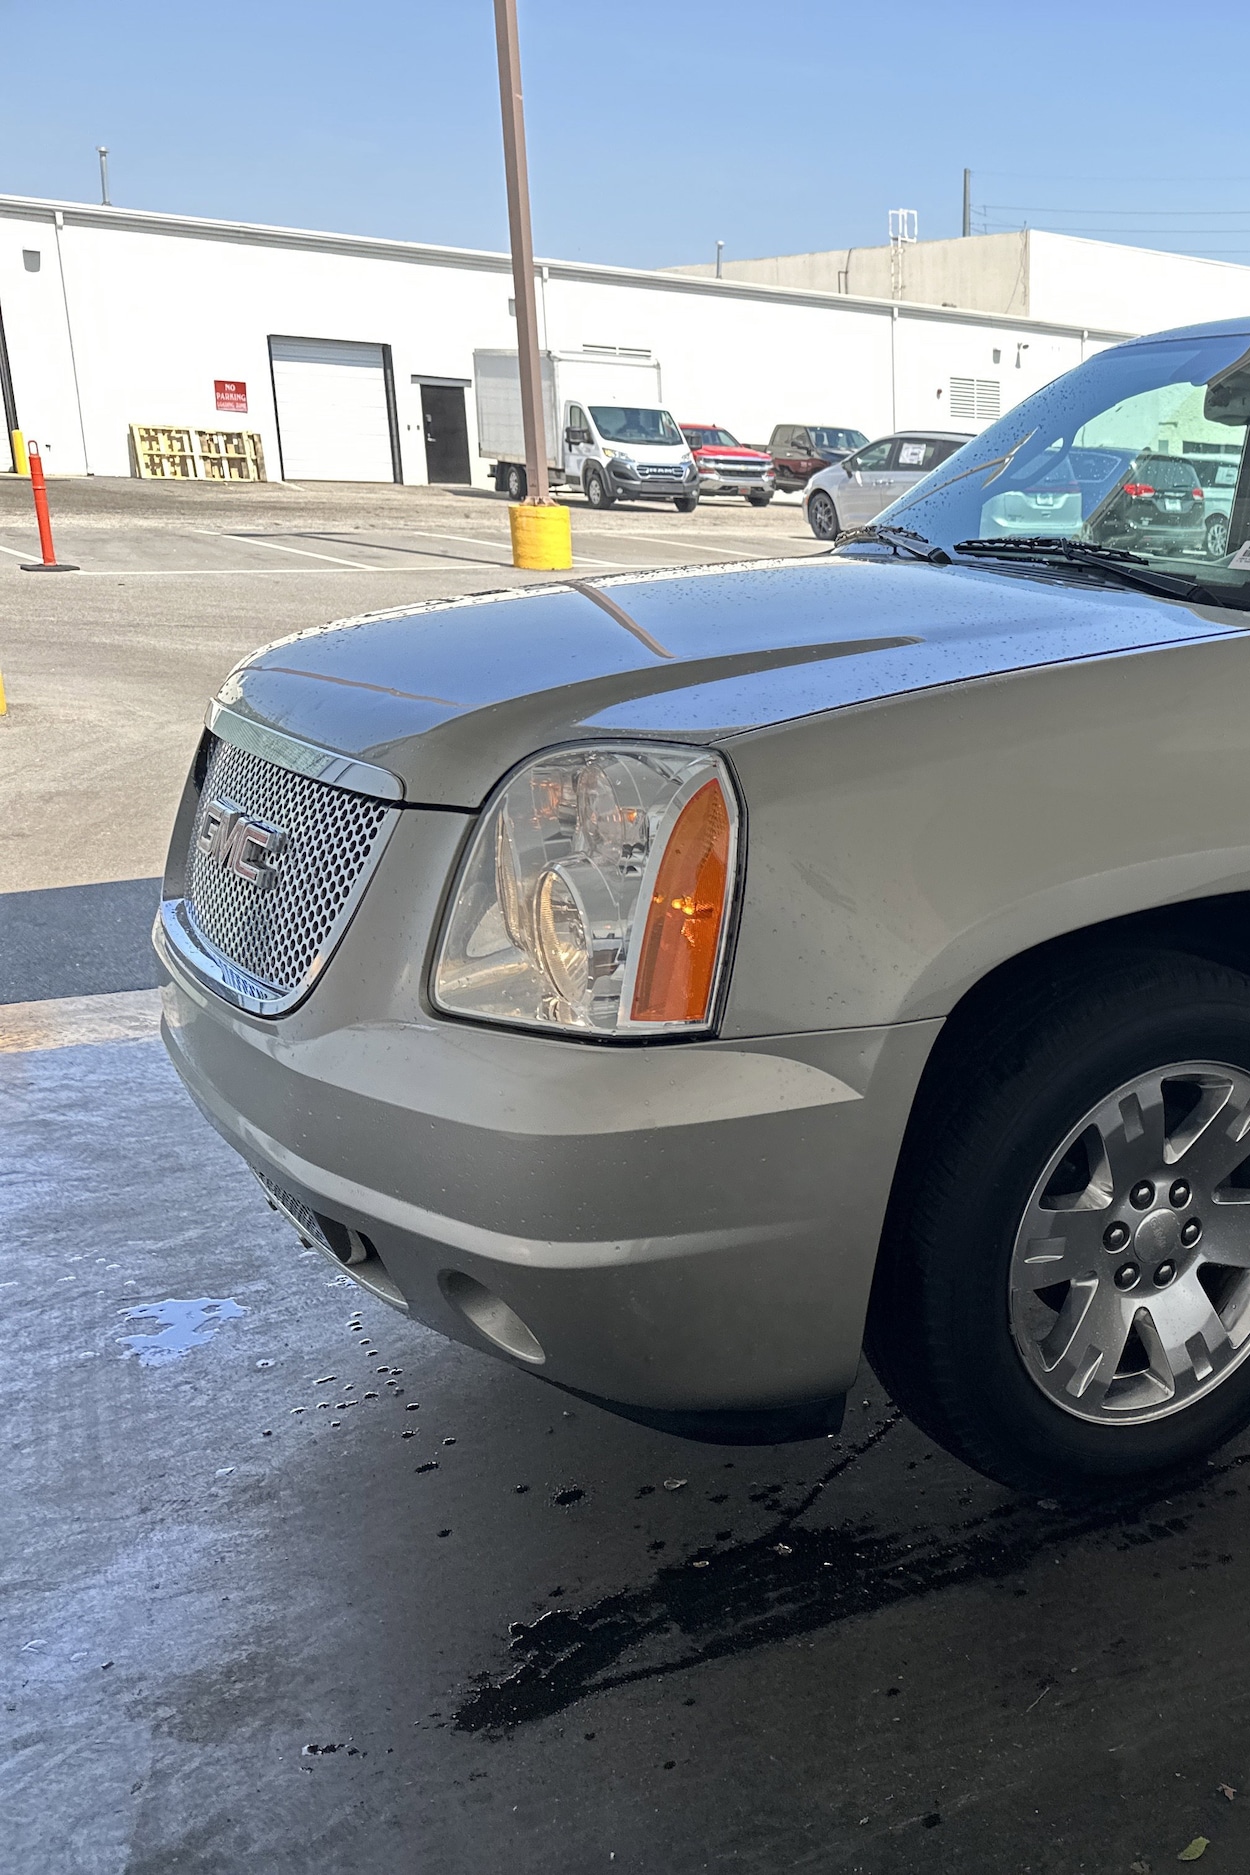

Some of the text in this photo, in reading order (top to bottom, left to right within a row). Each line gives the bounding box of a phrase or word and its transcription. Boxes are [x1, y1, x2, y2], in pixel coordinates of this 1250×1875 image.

[224, 383, 236, 391] NO
[216, 392, 246, 402] PARKING
[197, 799, 287, 891] GMC
